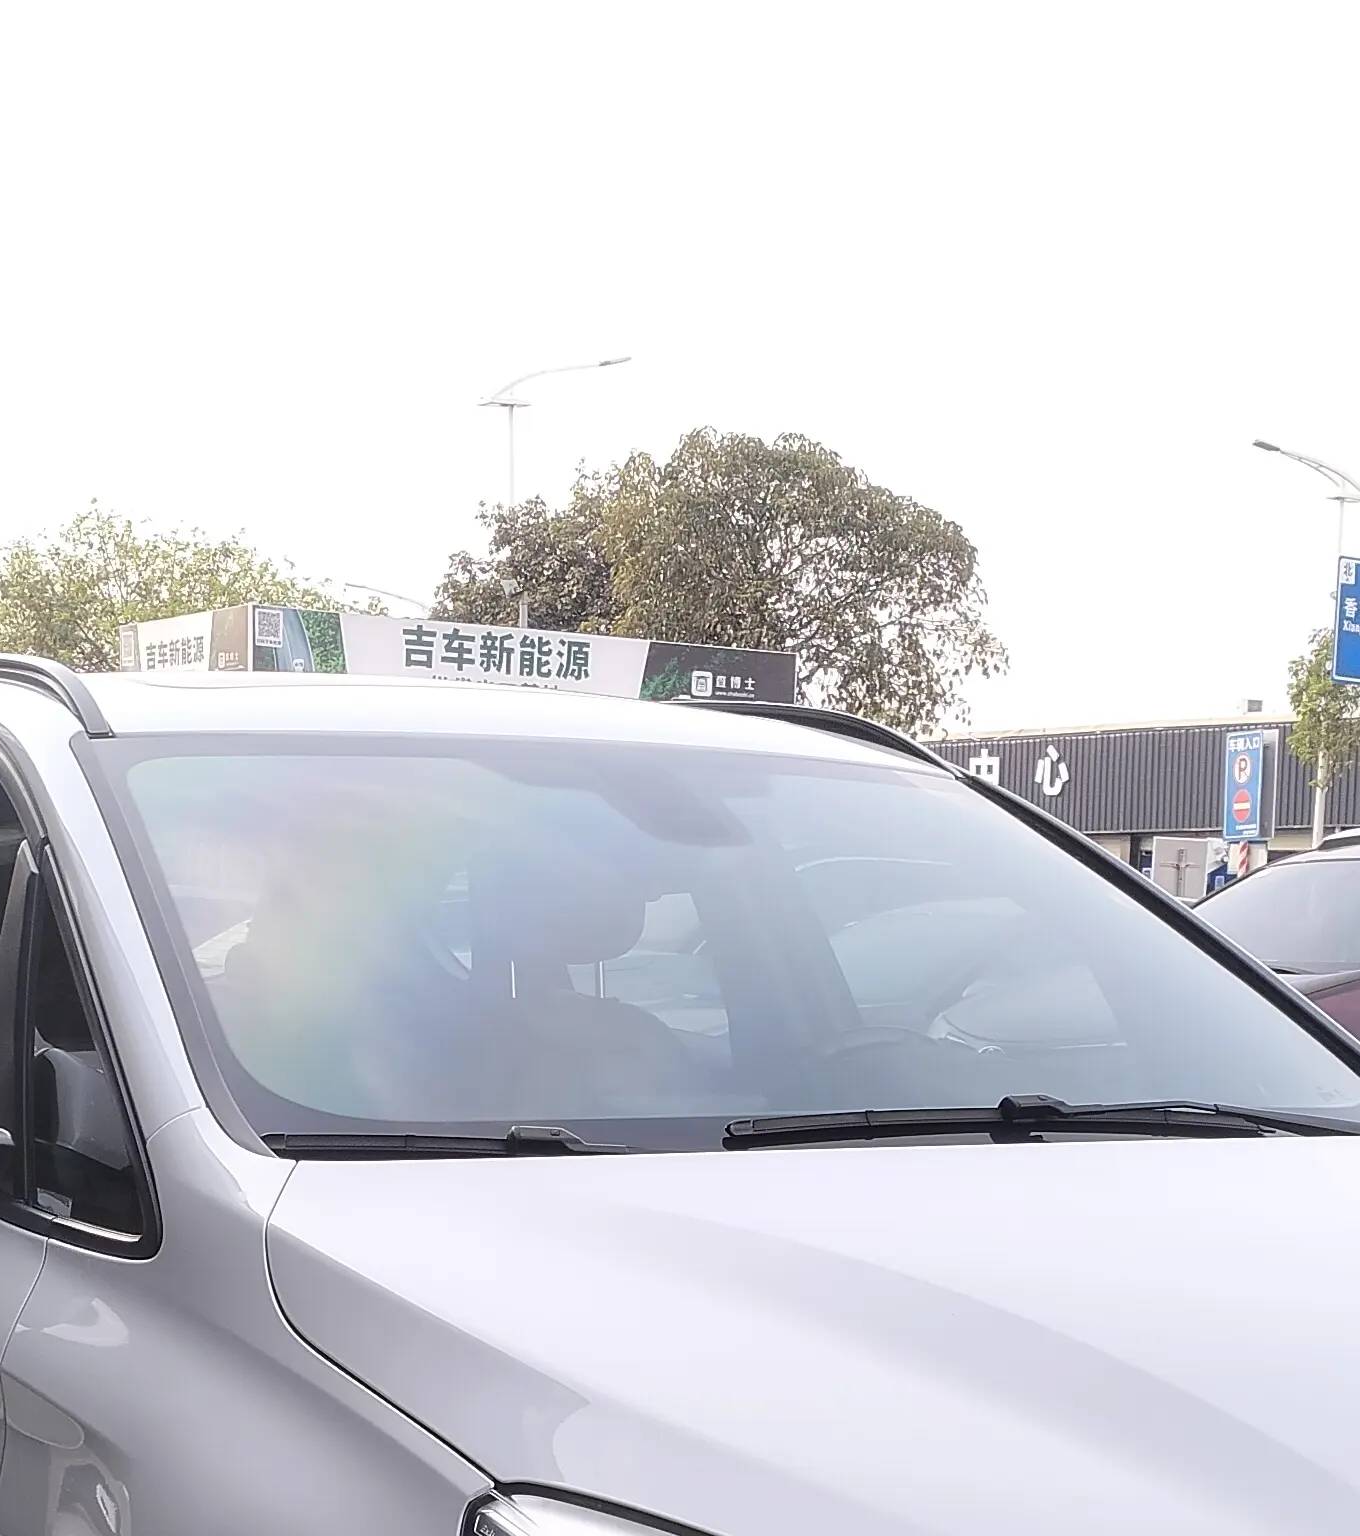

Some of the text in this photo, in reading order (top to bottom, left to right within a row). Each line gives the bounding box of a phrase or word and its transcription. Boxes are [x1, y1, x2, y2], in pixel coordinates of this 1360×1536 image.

[1343, 562, 1353, 577] 北
[145, 636, 205, 670] 吉车新能源
[402, 624, 591, 681] 吉车新能源
[969, 744, 1070, 796] 中心
